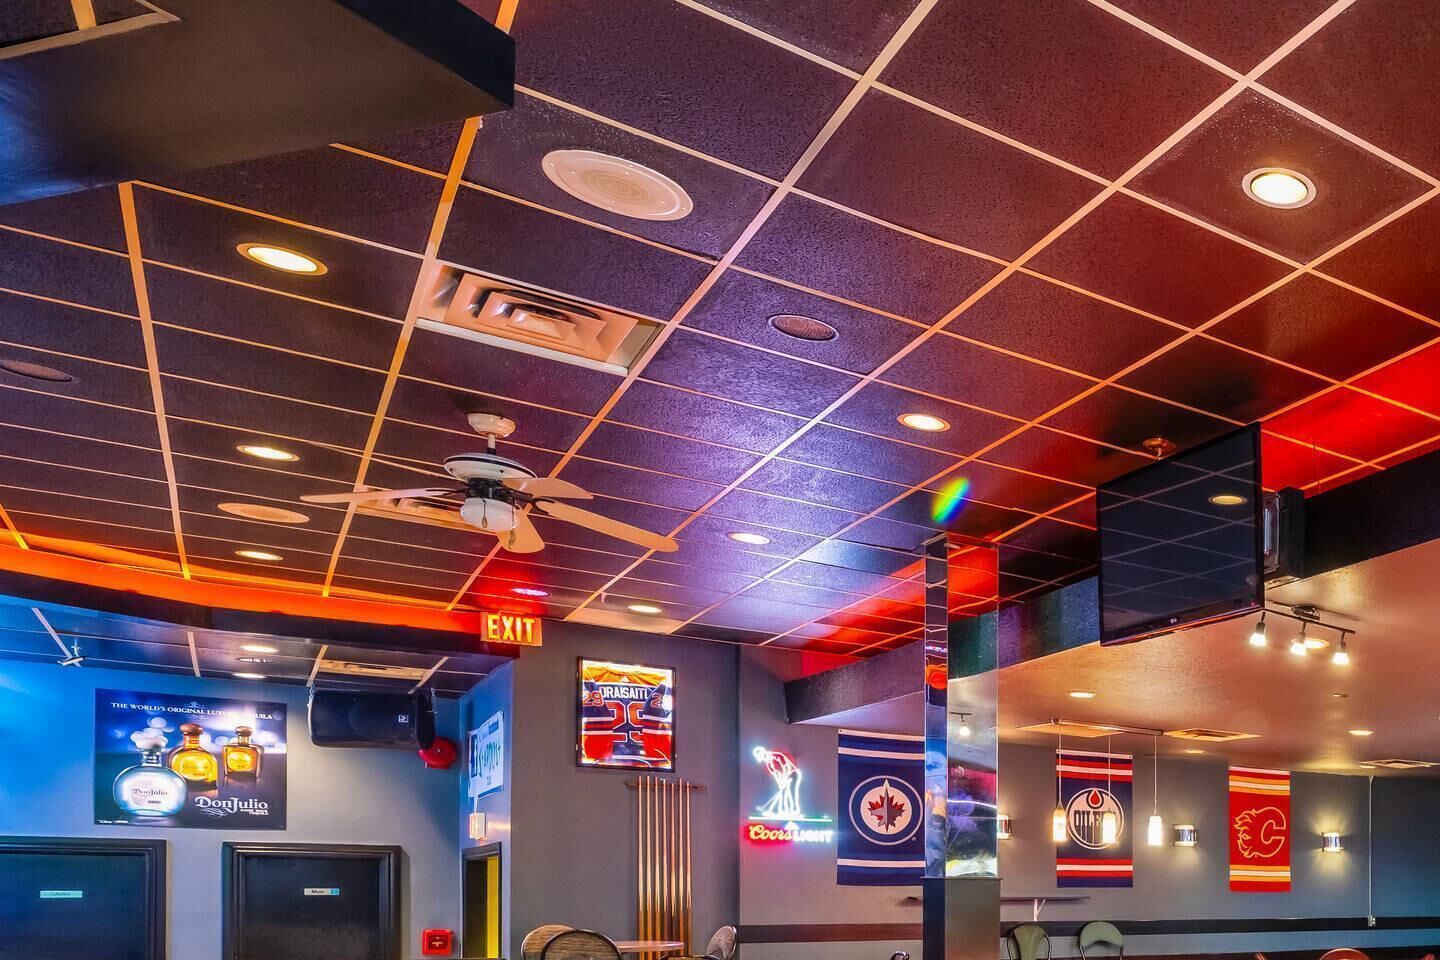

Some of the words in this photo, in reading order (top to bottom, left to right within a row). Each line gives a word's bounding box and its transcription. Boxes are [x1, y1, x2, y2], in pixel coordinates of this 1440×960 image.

[487, 614, 535, 642] EXIT
[130, 703, 166, 712] WORLD'S
[167, 706, 206, 715] ORIGINAL
[748, 824, 793, 841] Coors
